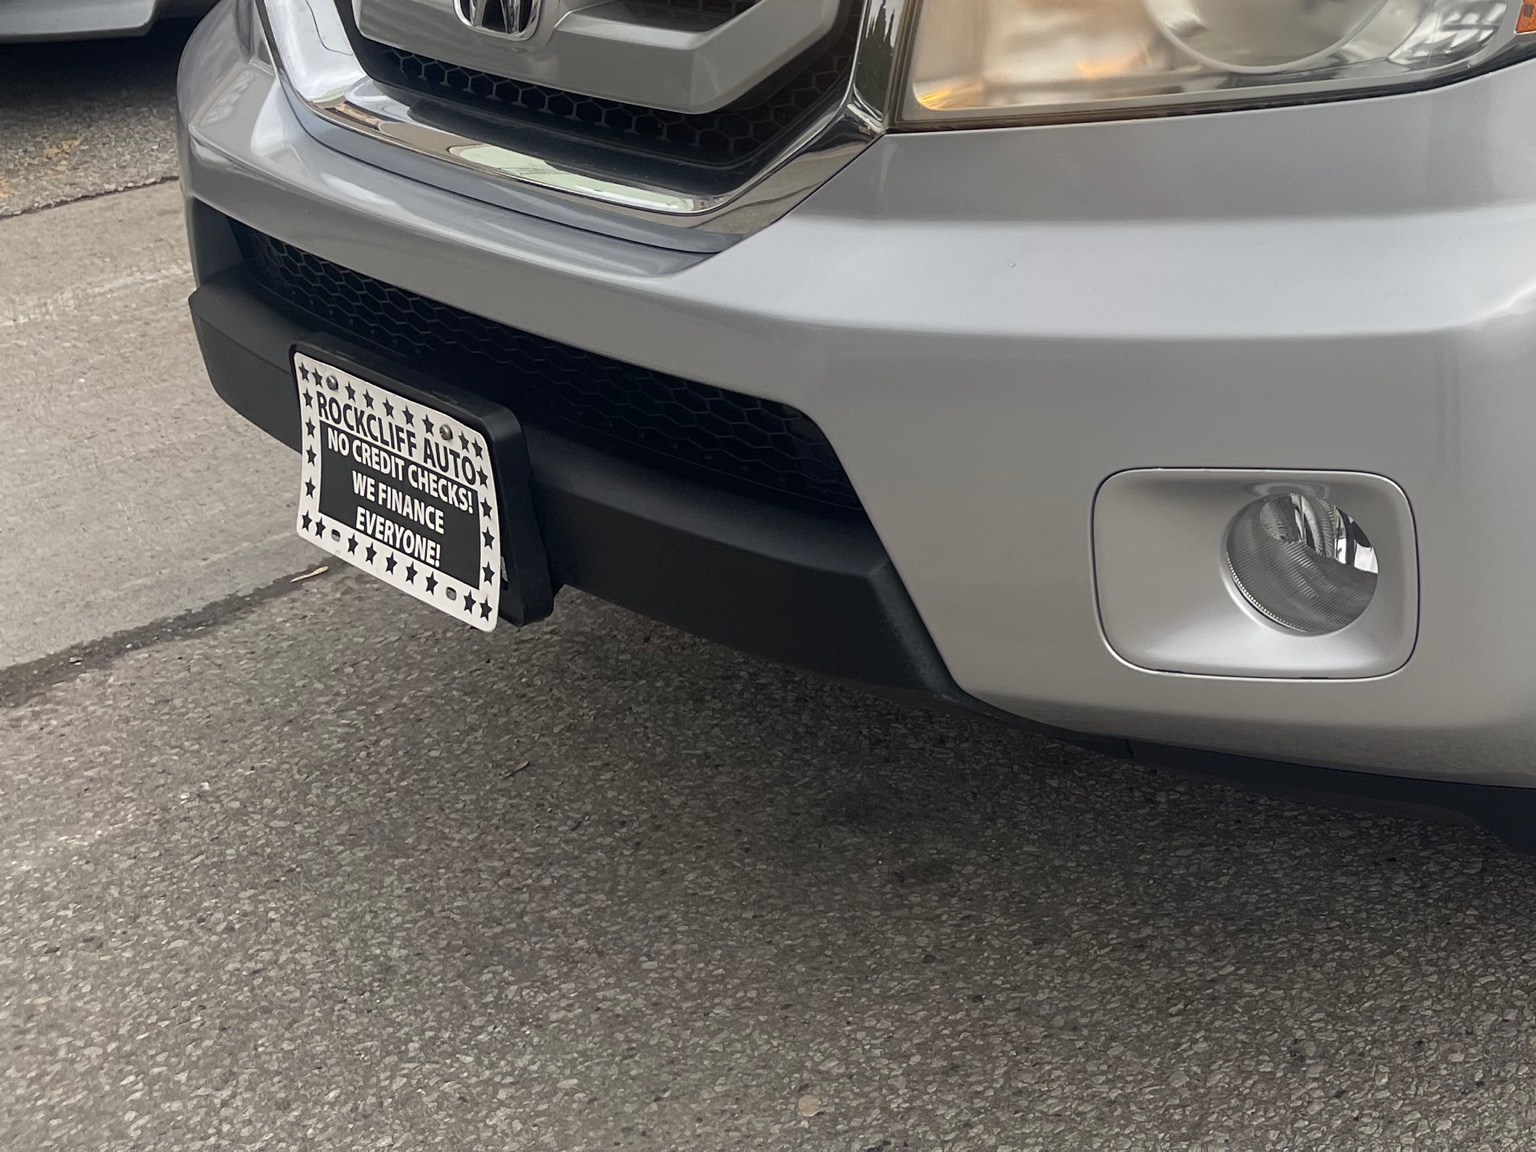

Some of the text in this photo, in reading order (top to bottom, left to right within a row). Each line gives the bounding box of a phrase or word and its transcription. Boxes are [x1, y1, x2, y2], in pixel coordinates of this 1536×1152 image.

[316, 391, 477, 486] ROCKCLIFF AUTO
[327, 427, 474, 514] NO CREDIT CHECKS!
[352, 470, 445, 535] WE FINANCE
[355, 506, 441, 568] EVERYONE!
